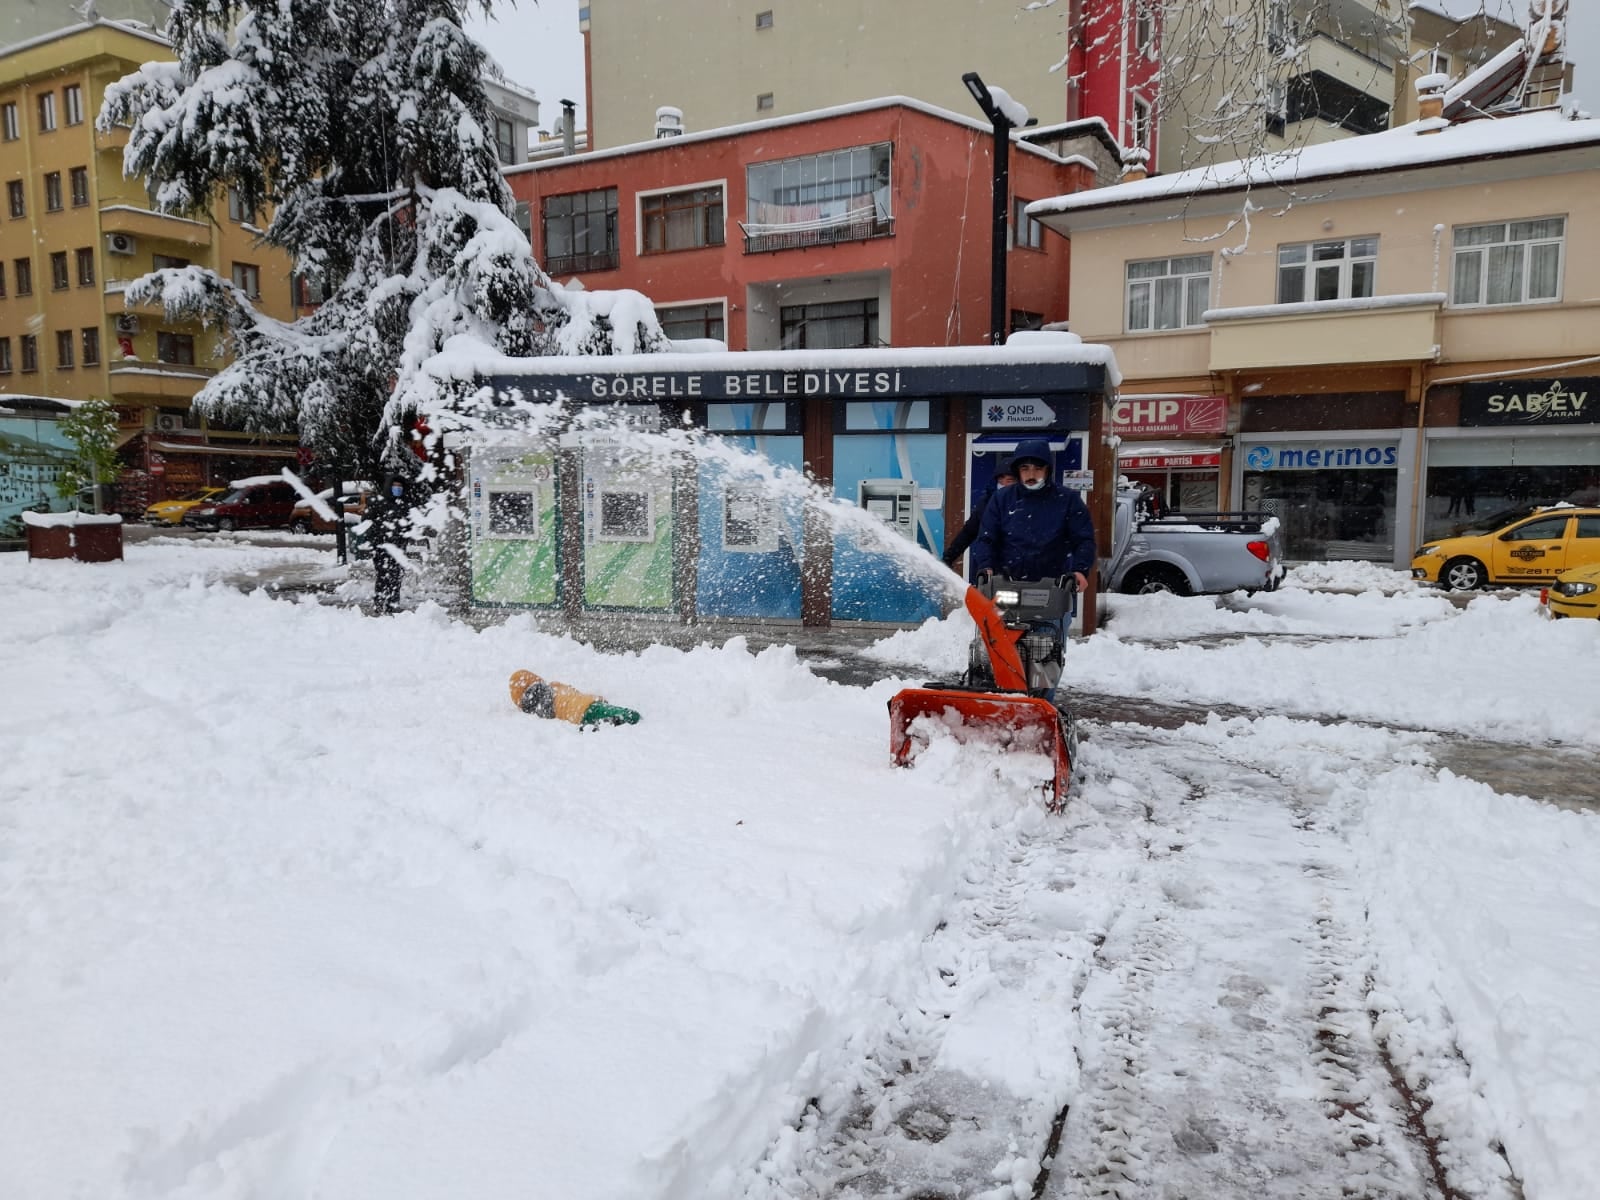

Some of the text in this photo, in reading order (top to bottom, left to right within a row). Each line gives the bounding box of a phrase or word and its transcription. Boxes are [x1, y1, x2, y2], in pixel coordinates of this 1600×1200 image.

[591, 368, 901, 397] GÖRELE BELEDİYESİ
[1007, 404, 1035, 415] QNB
[1112, 400, 1180, 425] CHP
[1546, 410, 1581, 418] SARAR
[1139, 457, 1158, 466] HALK
[1164, 455, 1192, 466] PARTİSİ
[1278, 446, 1397, 468] merinos
